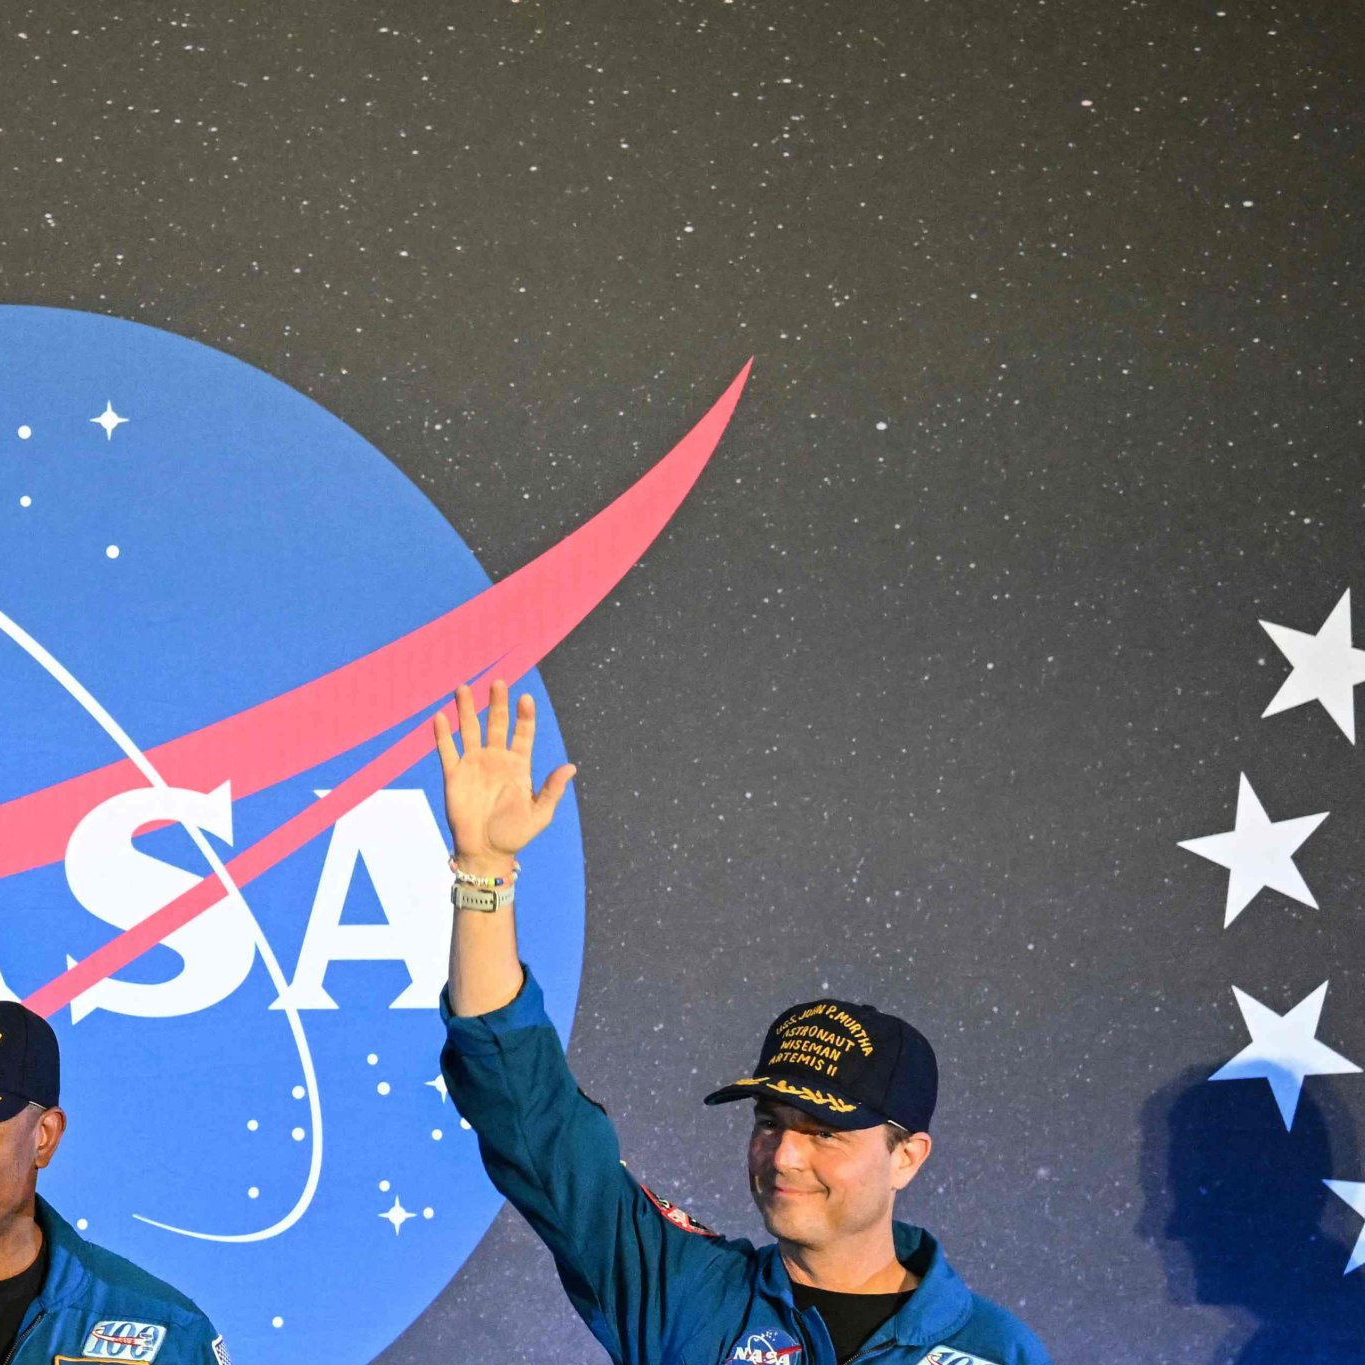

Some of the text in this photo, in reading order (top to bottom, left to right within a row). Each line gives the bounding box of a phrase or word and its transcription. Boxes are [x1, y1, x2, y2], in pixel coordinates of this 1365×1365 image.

[782, 1026, 855, 1052] ASTRONAUT
[826, 1005, 837, 1019] P.
[834, 1011, 874, 1057] MURTHA
[768, 1052, 825, 1071] ARTEMIS
[780, 1040, 841, 1061] WISEMAN
[87, 1322, 160, 1359] 100
